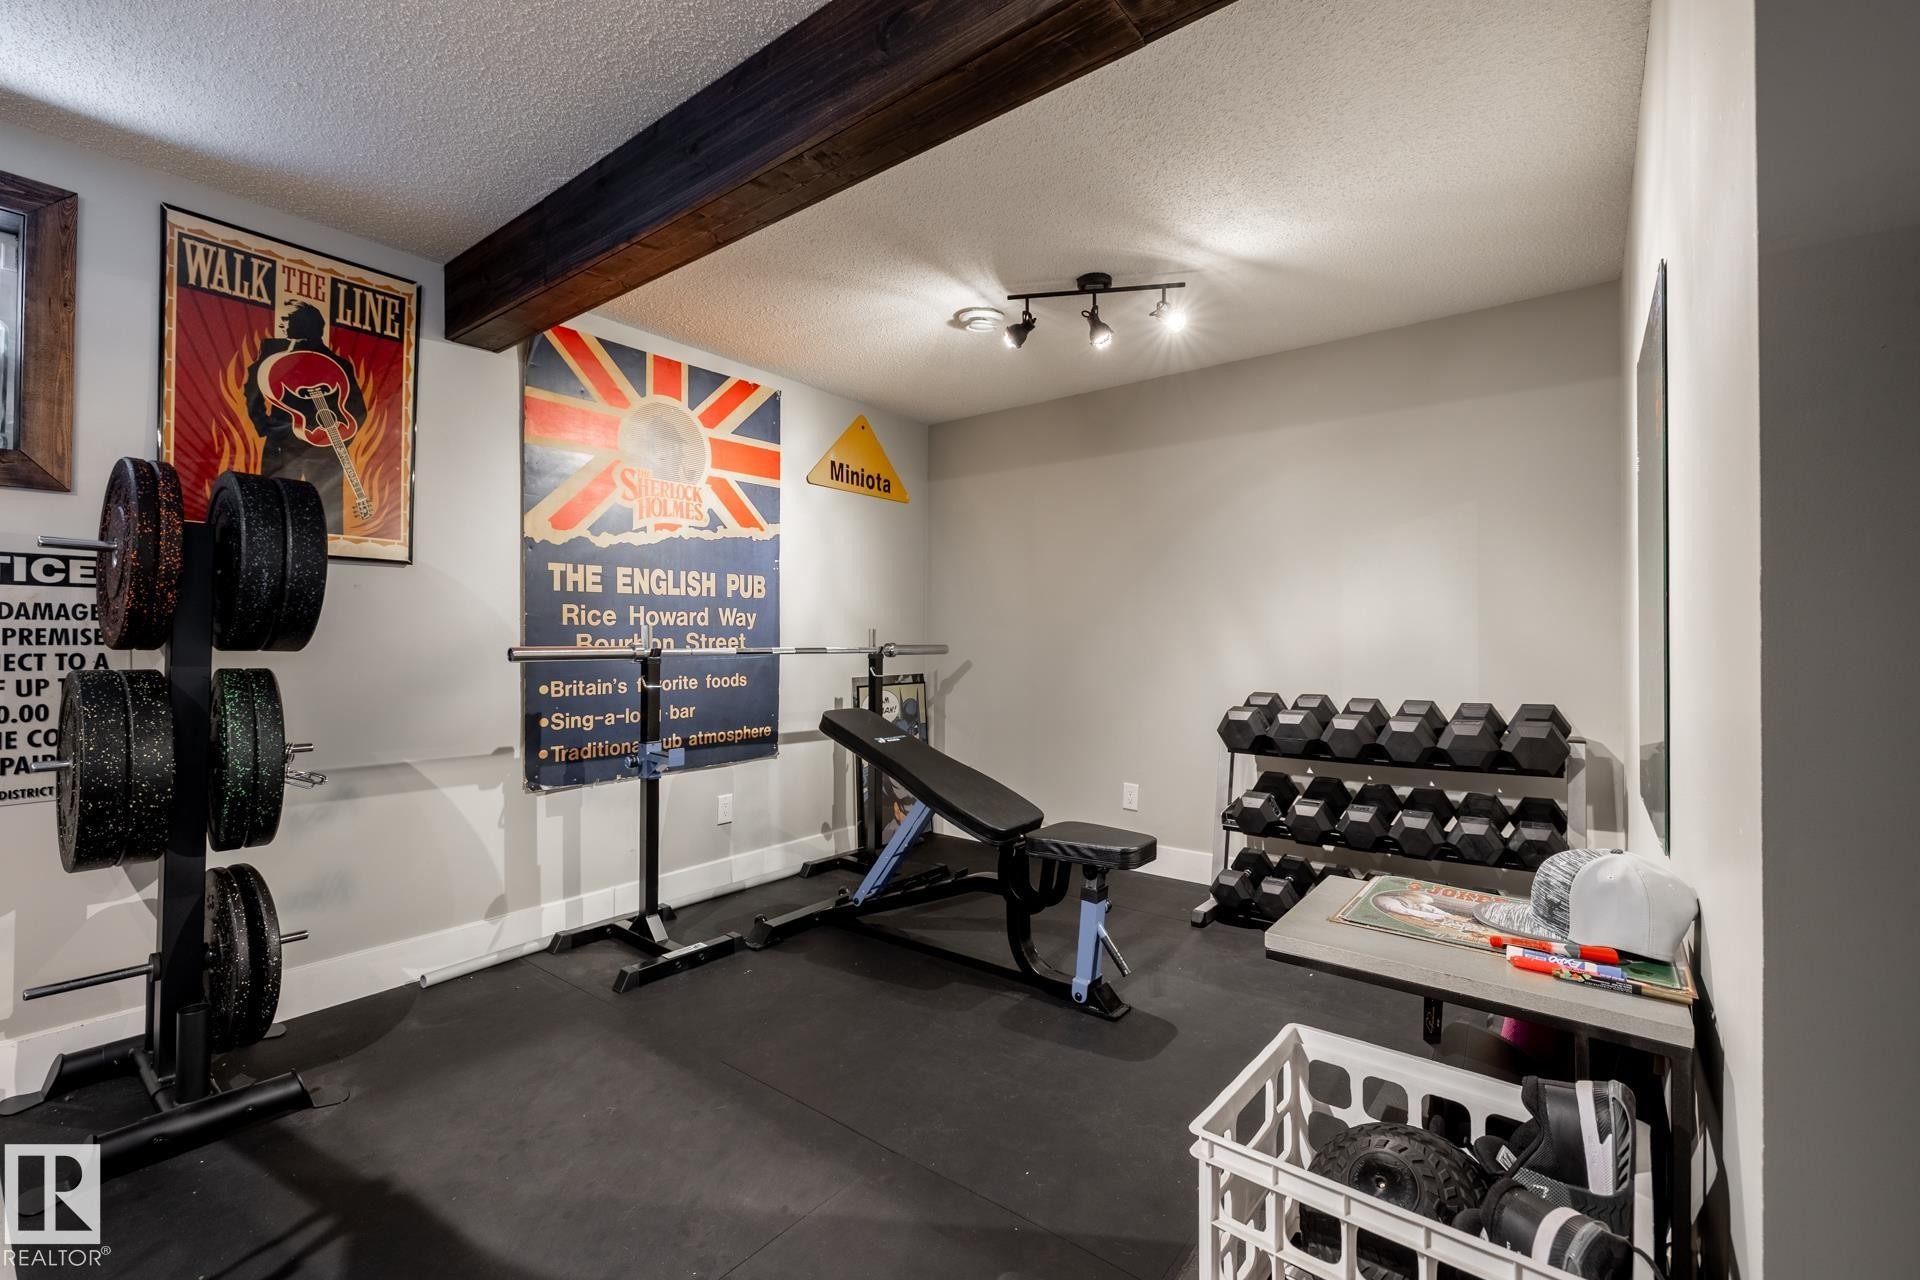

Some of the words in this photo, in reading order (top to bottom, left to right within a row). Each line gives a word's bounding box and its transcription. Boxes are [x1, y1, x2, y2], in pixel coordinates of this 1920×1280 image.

[182, 237, 272, 306] WALK
[282, 264, 326, 302] THE
[336, 283, 400, 338] LINE
[621, 468, 703, 504] SHERLOCK
[830, 460, 891, 494] Miniota
[639, 497, 704, 521] HOLMES
[548, 562, 602, 593] THE
[617, 566, 716, 598] ENGLISH
[727, 573, 766, 599] PUB
[562, 603, 617, 626] Rice
[630, 605, 709, 626] Howard
[718, 607, 756, 630] Way
[685, 632, 746, 649] Street
[55, 653, 86, 670] TO
[93, 652, 109, 669] A
[16, 678, 50, 697] UP
[551, 678, 628, 698] Britain's
[706, 673, 748, 689] foods
[551, 707, 661, 731] Sing-a-lo
[669, 704, 696, 720] bar
[551, 740, 640, 762] Traditiona
[662, 733, 683, 750] ub
[689, 725, 772, 746] atmosphere
[0, 786, 54, 801] DISTRICT
